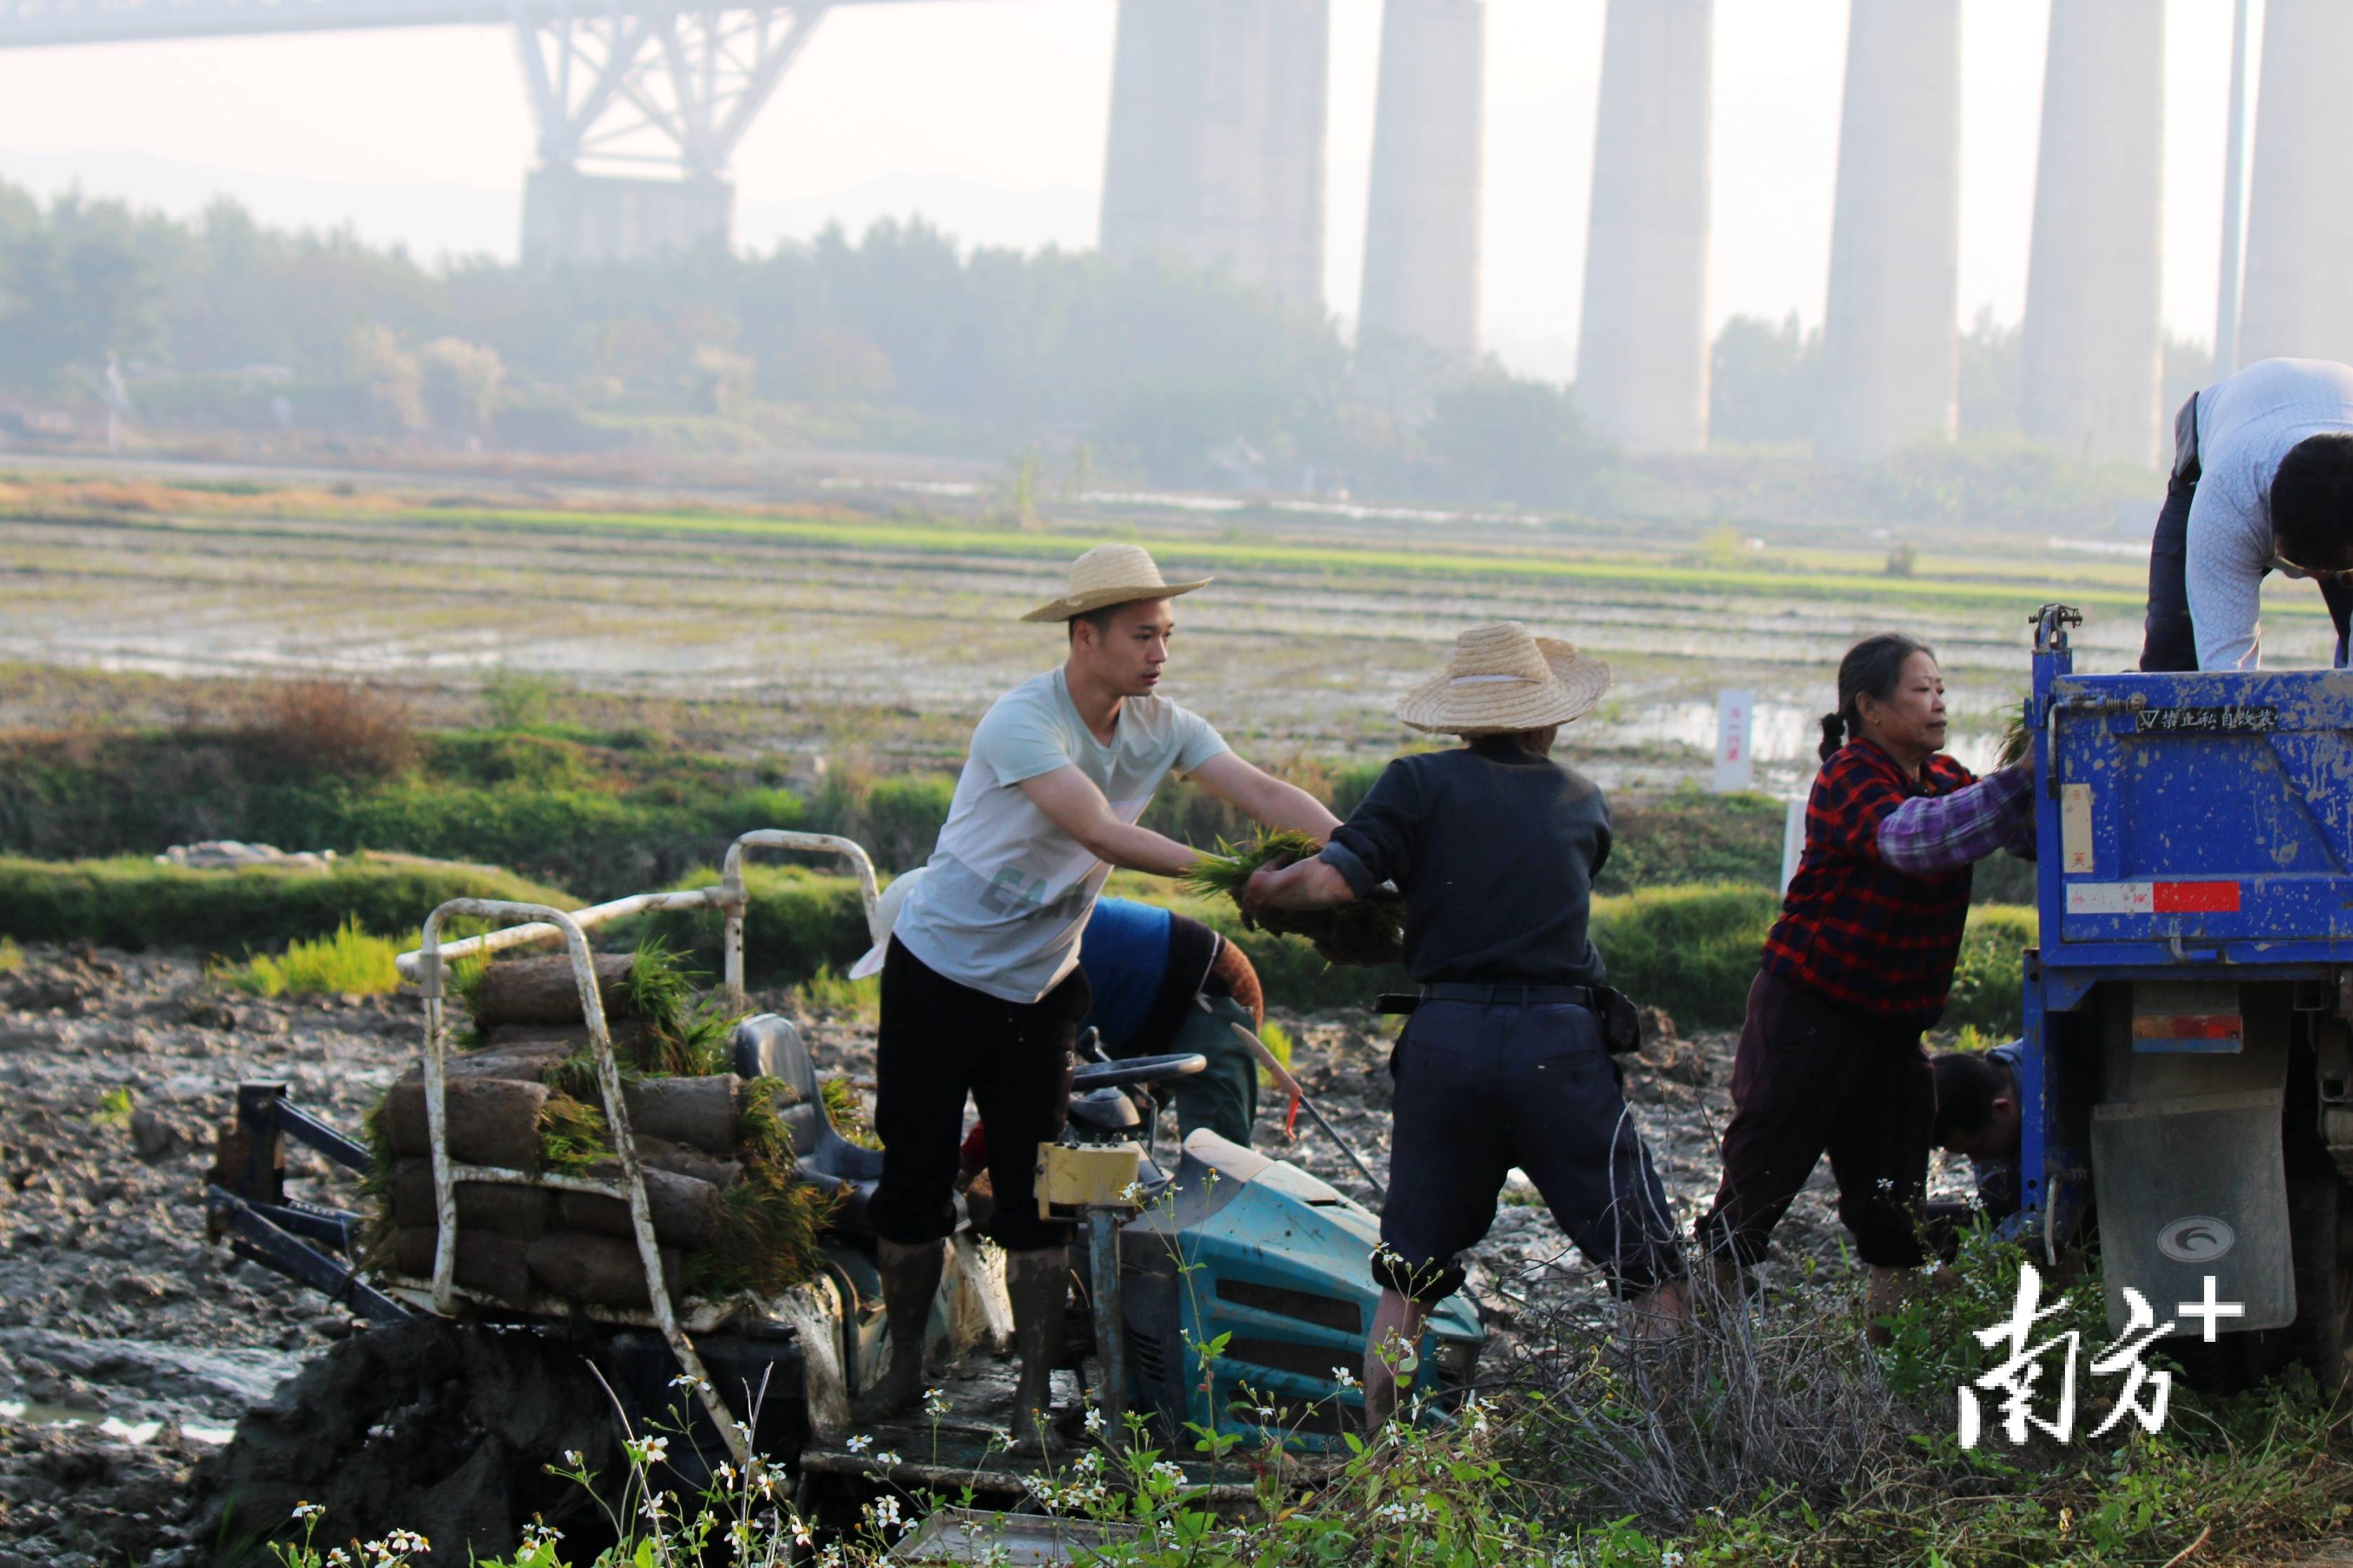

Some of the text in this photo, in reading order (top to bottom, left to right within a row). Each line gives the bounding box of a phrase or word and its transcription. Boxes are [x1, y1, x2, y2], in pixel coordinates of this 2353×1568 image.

[2162, 709, 2275, 728] 禁止私自改装
